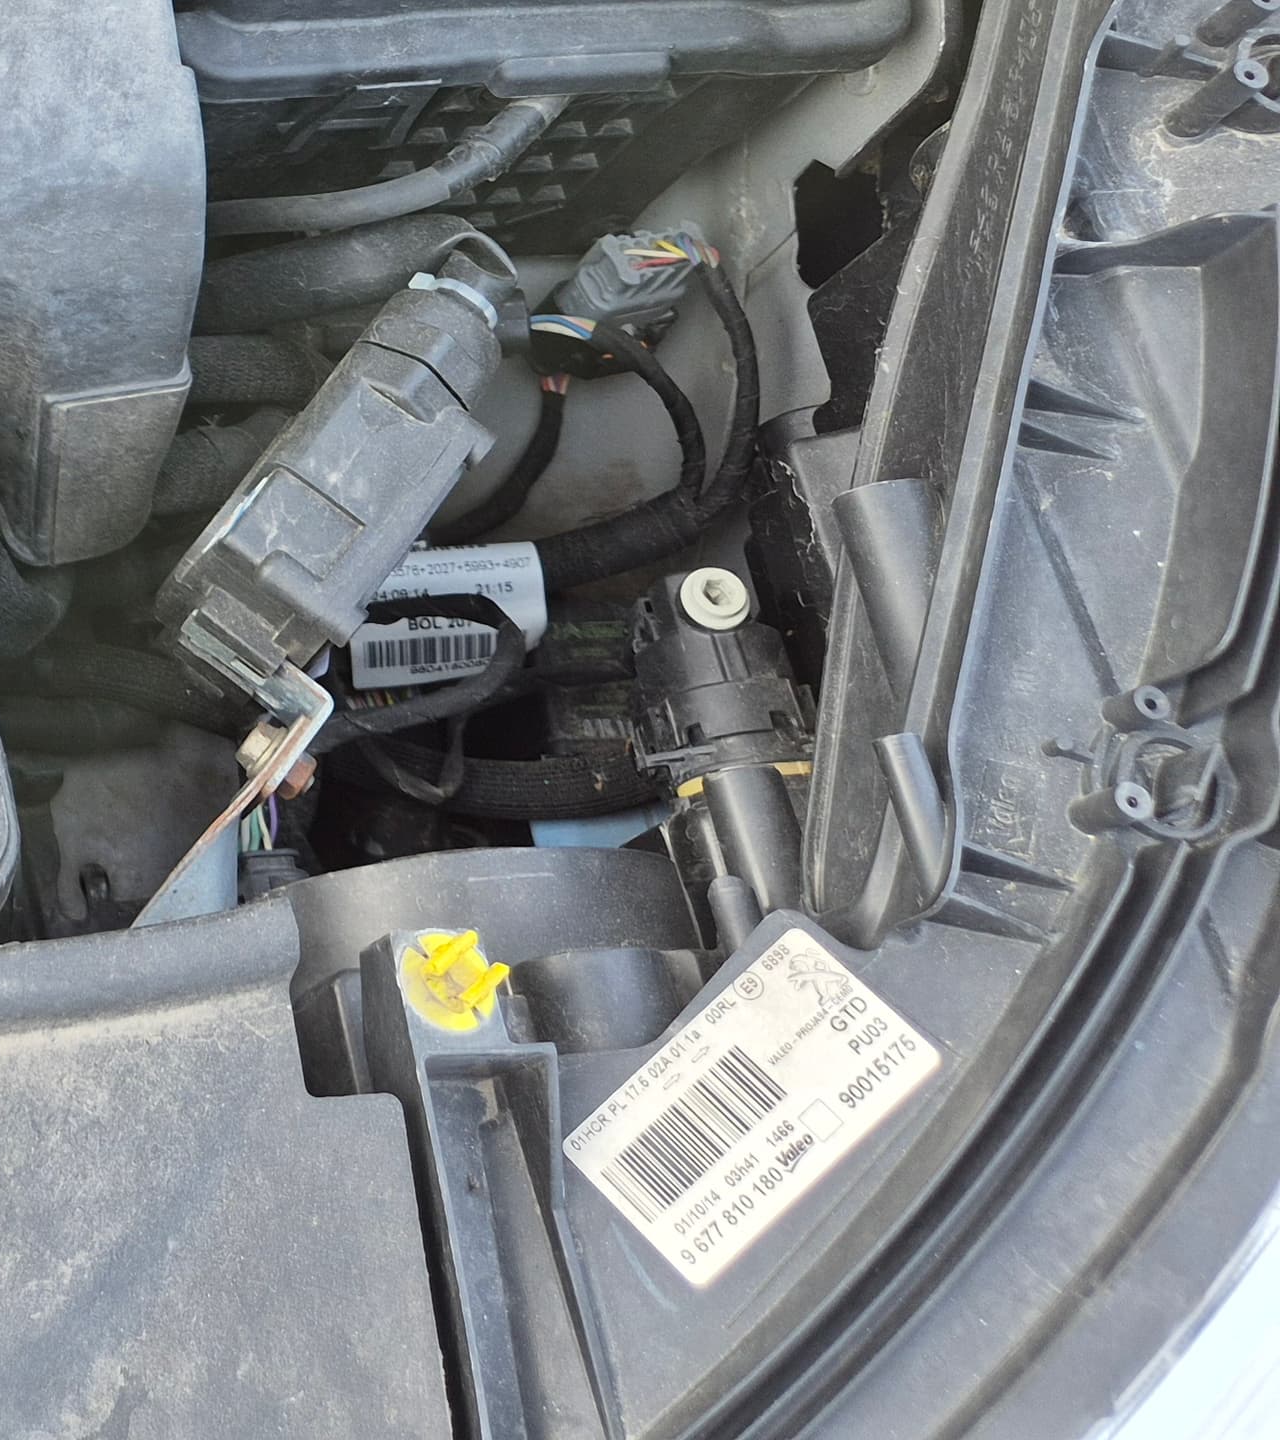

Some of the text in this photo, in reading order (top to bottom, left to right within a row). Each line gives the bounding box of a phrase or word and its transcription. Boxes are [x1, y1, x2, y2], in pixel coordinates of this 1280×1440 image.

[740, 976, 758, 994] E9
[827, 993, 869, 1034] GTD
[767, 1041, 793, 1066] VALEO
[846, 1014, 889, 1055] PU03
[672, 1118, 794, 1235] 01/10/14 03h41 1466
[691, 1219, 726, 1254] 677
[720, 1191, 756, 1227] 810
[749, 1164, 785, 1199] 180
[774, 1129, 815, 1169] Valeo
